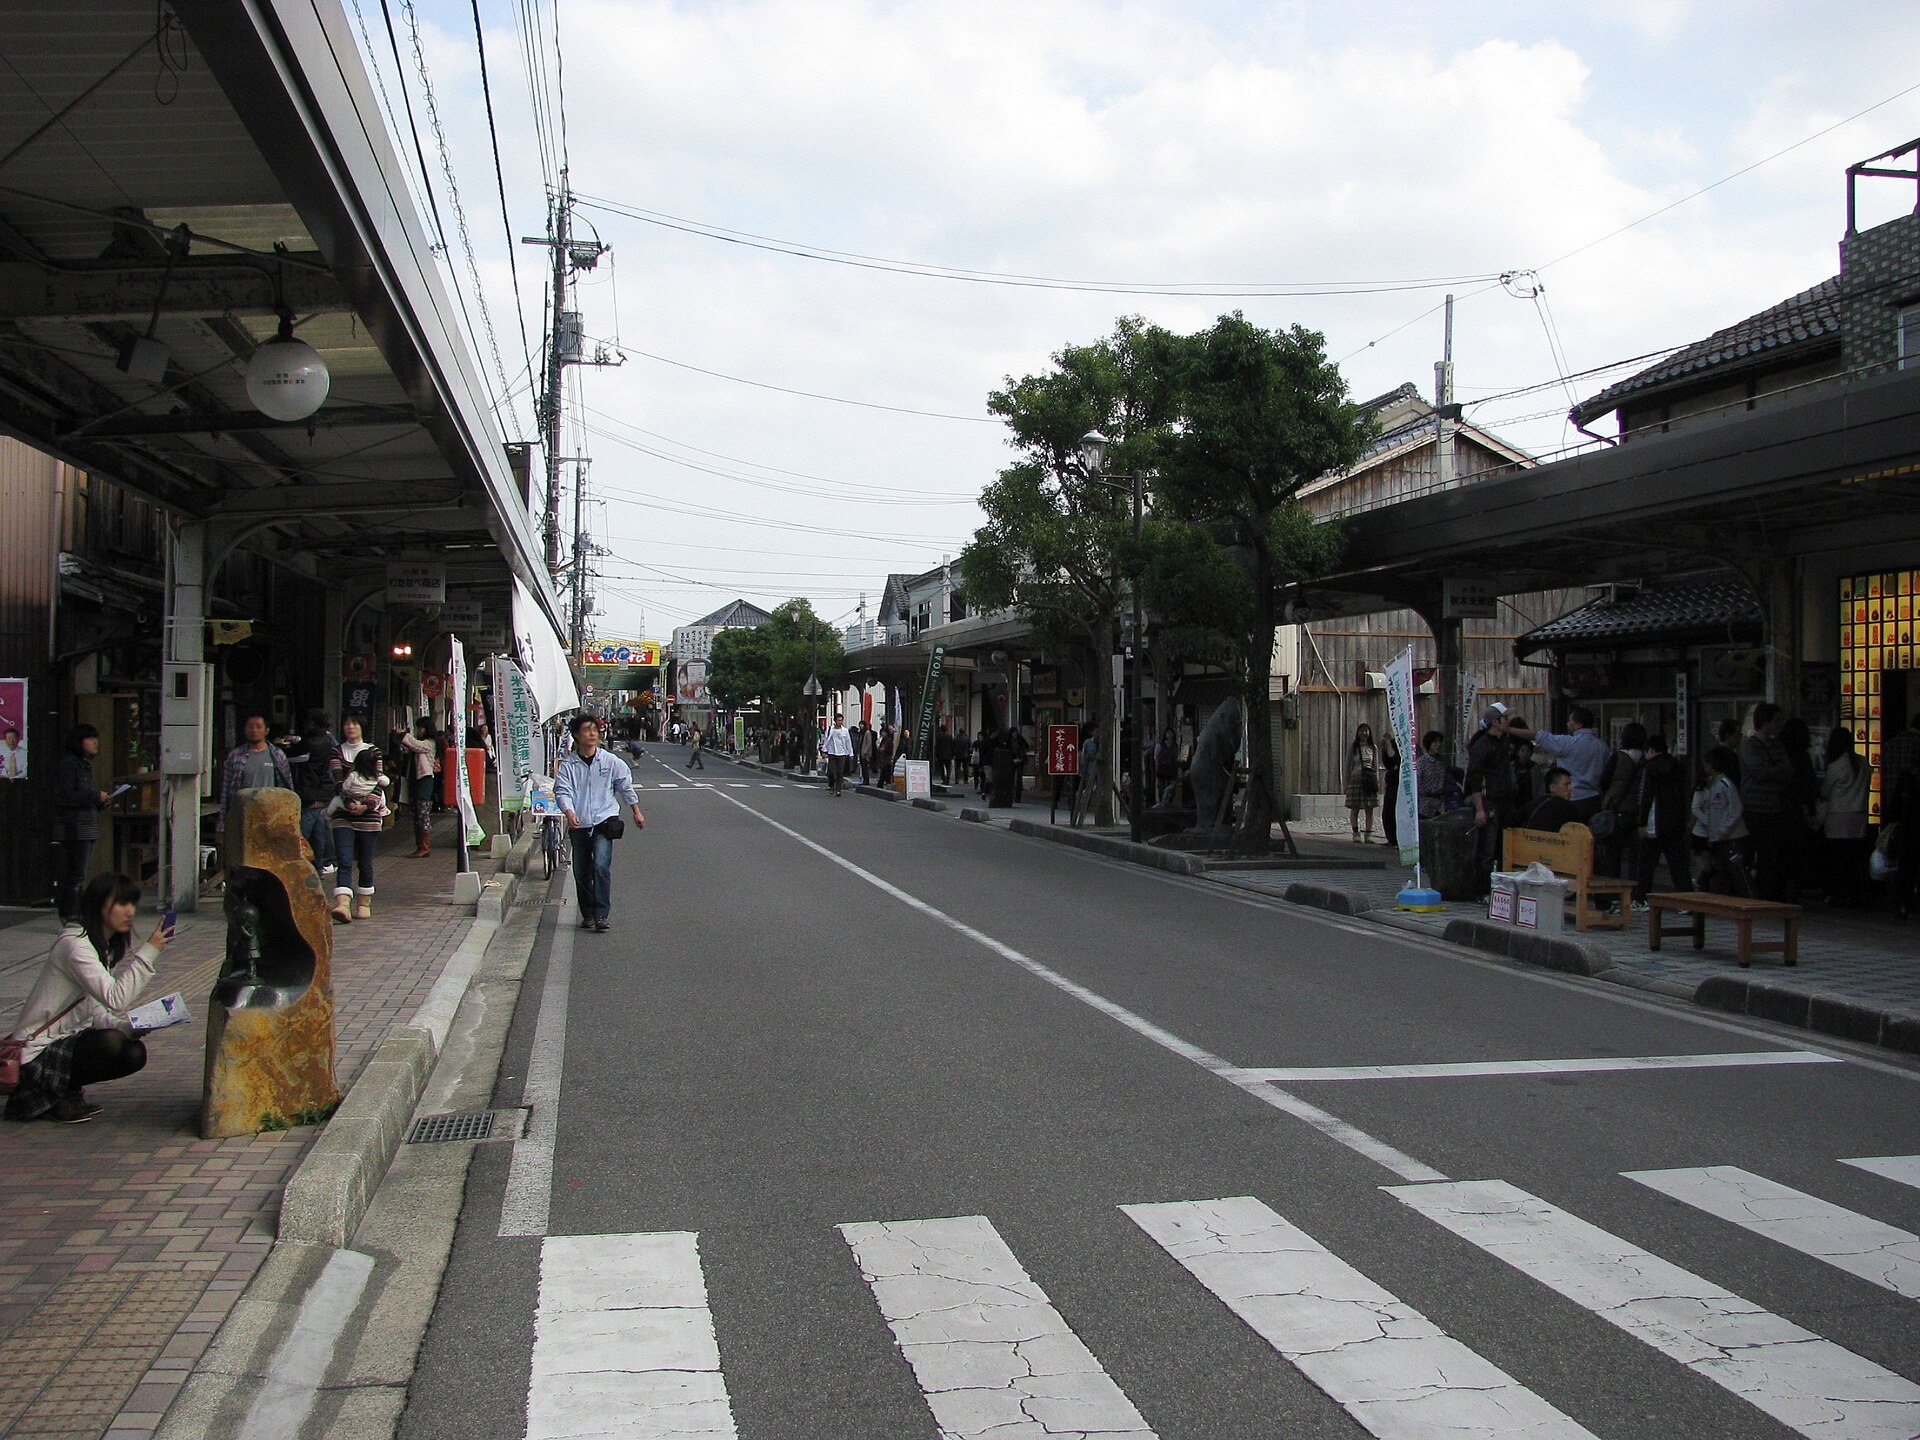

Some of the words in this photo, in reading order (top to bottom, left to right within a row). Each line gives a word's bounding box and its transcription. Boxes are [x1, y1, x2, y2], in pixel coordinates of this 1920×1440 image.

[388, 578, 441, 589] わたなべ商店
[919, 702, 934, 741] MIZUKI
[931, 647, 944, 677] ROAD
